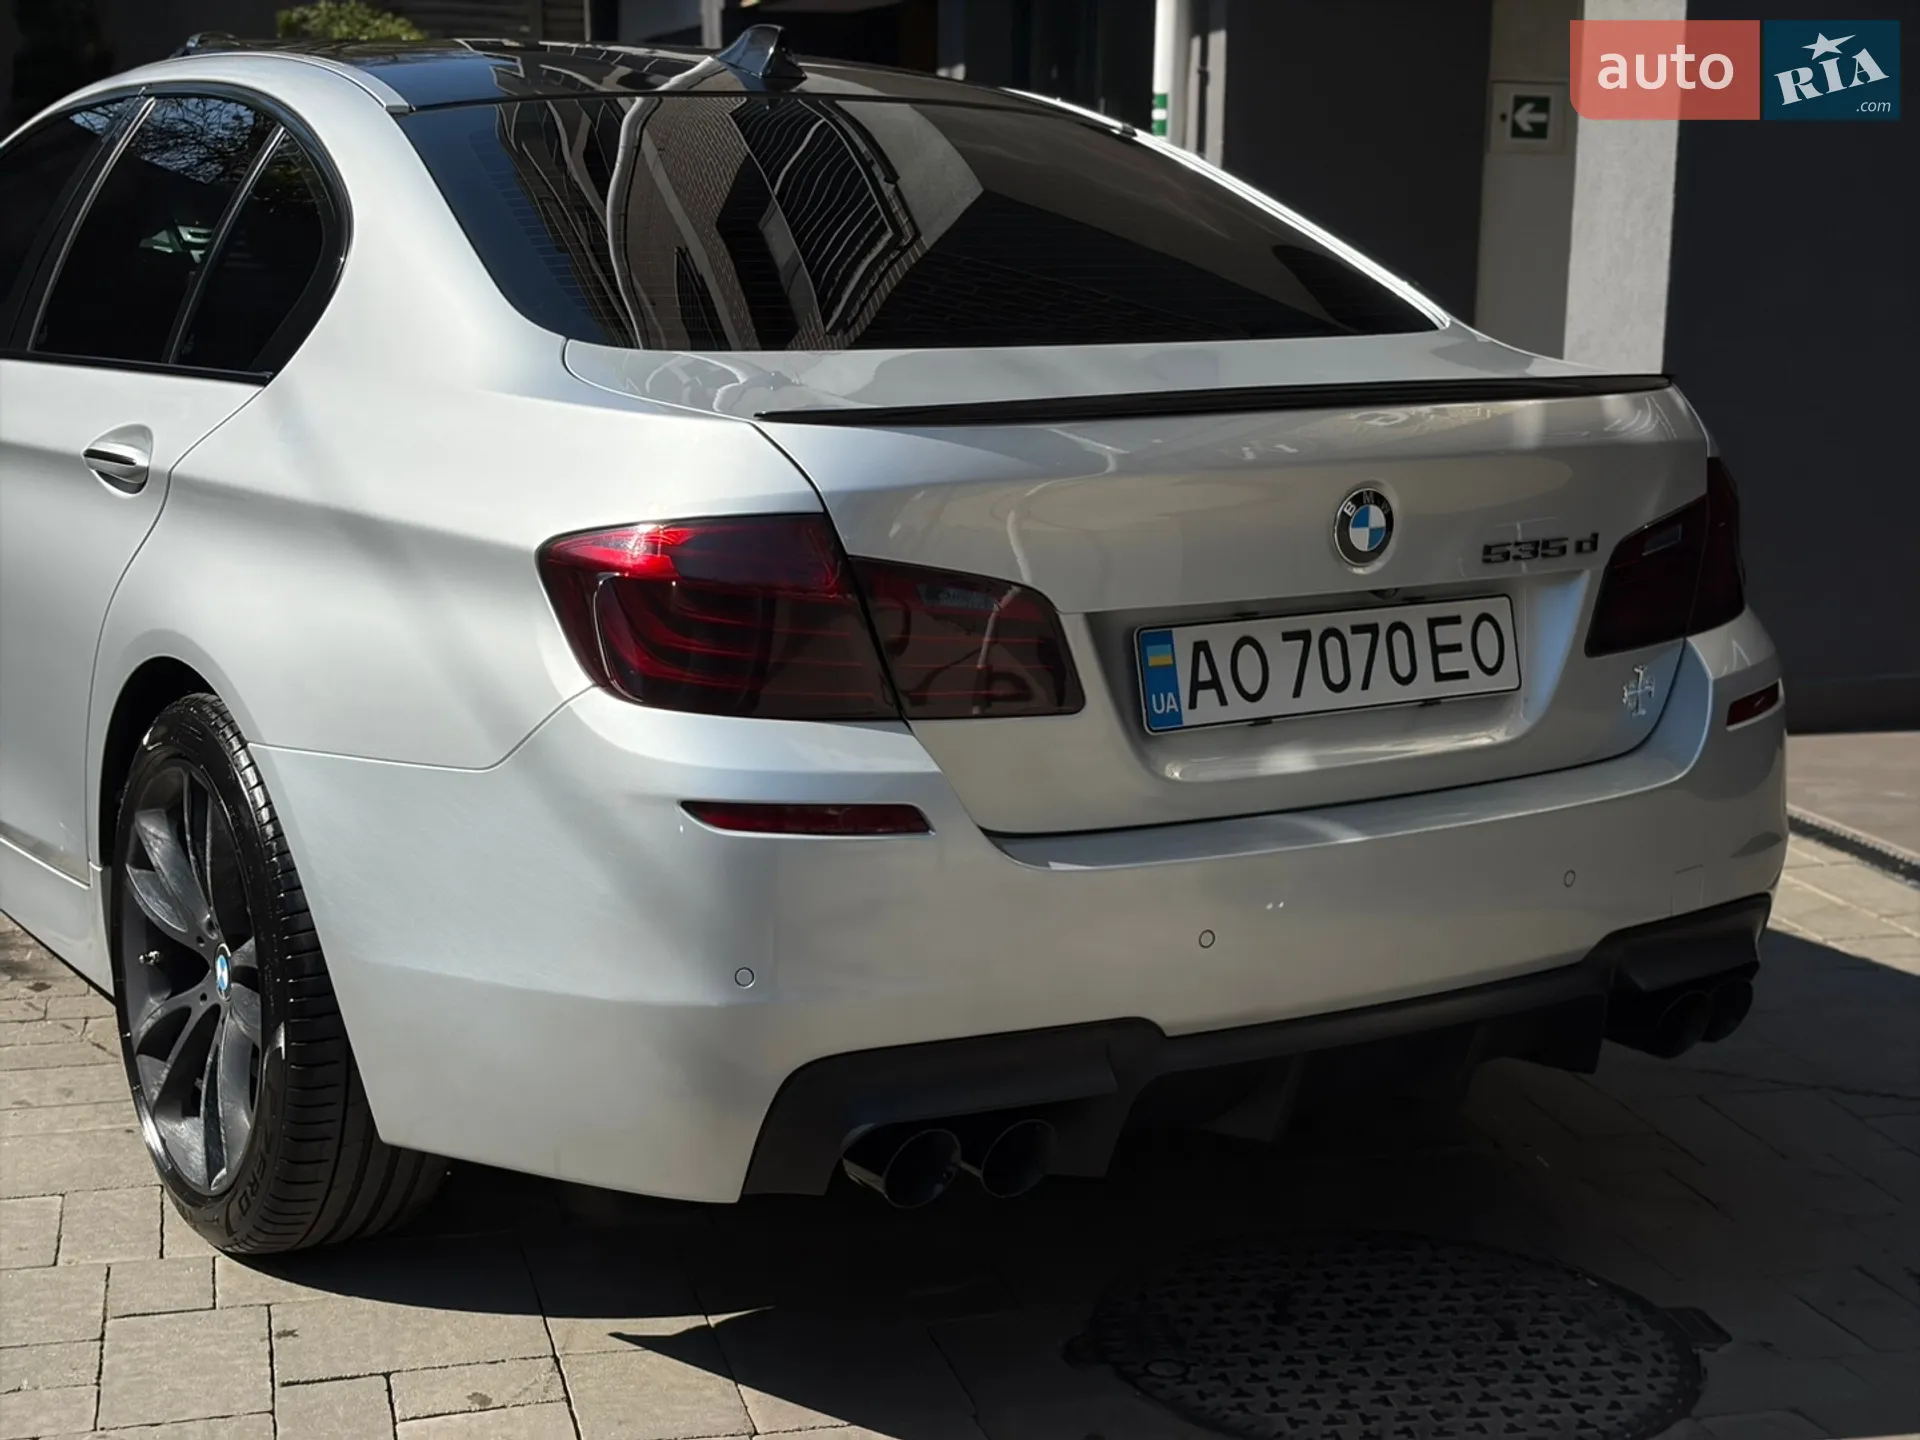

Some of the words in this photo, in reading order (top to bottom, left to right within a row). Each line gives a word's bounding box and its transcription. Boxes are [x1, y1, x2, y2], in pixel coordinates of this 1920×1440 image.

[1187, 635, 1269, 711] AO
[1281, 621, 1418, 699] 7070
[1427, 612, 1505, 683] EO
[1151, 692, 1179, 715] UA
